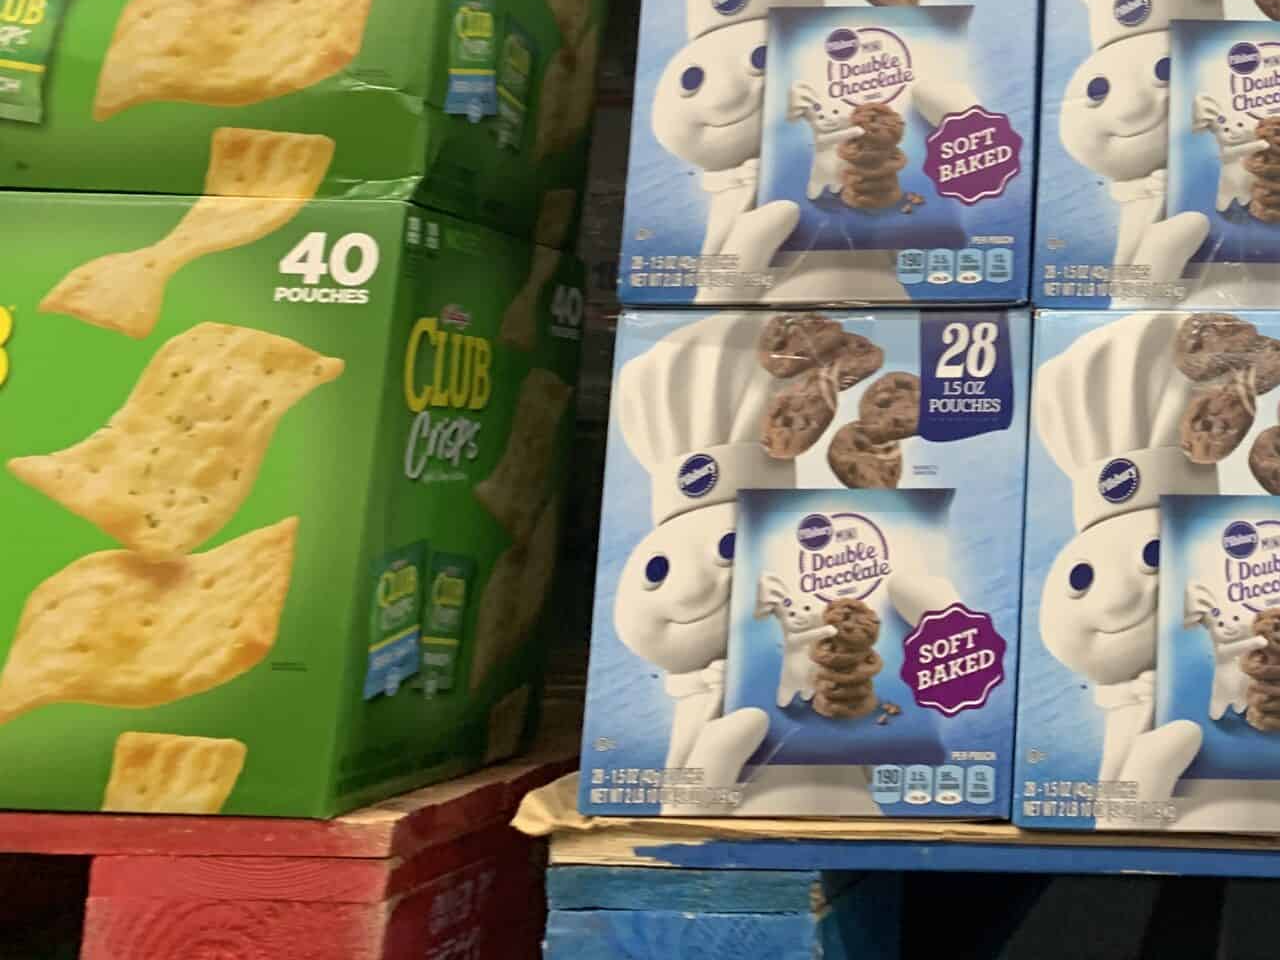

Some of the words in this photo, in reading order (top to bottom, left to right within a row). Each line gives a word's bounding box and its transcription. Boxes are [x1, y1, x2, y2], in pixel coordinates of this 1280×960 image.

[839, 52, 900, 80] Double
[828, 68, 914, 99] Chocolate
[941, 127, 996, 159] SOFT
[938, 145, 1012, 183] BAKED
[279, 231, 380, 286] 40
[273, 286, 369, 305] POUCHES
[404, 316, 493, 413] CLUB
[935, 321, 998, 379] 28
[964, 380, 985, 395] OZ
[928, 398, 1001, 414] POUCHES
[811, 542, 878, 572] Double
[799, 558, 892, 594] Chocolate
[918, 628, 979, 664] SOFT
[916, 649, 996, 691] BAKED
[877, 769, 898, 785] 190
